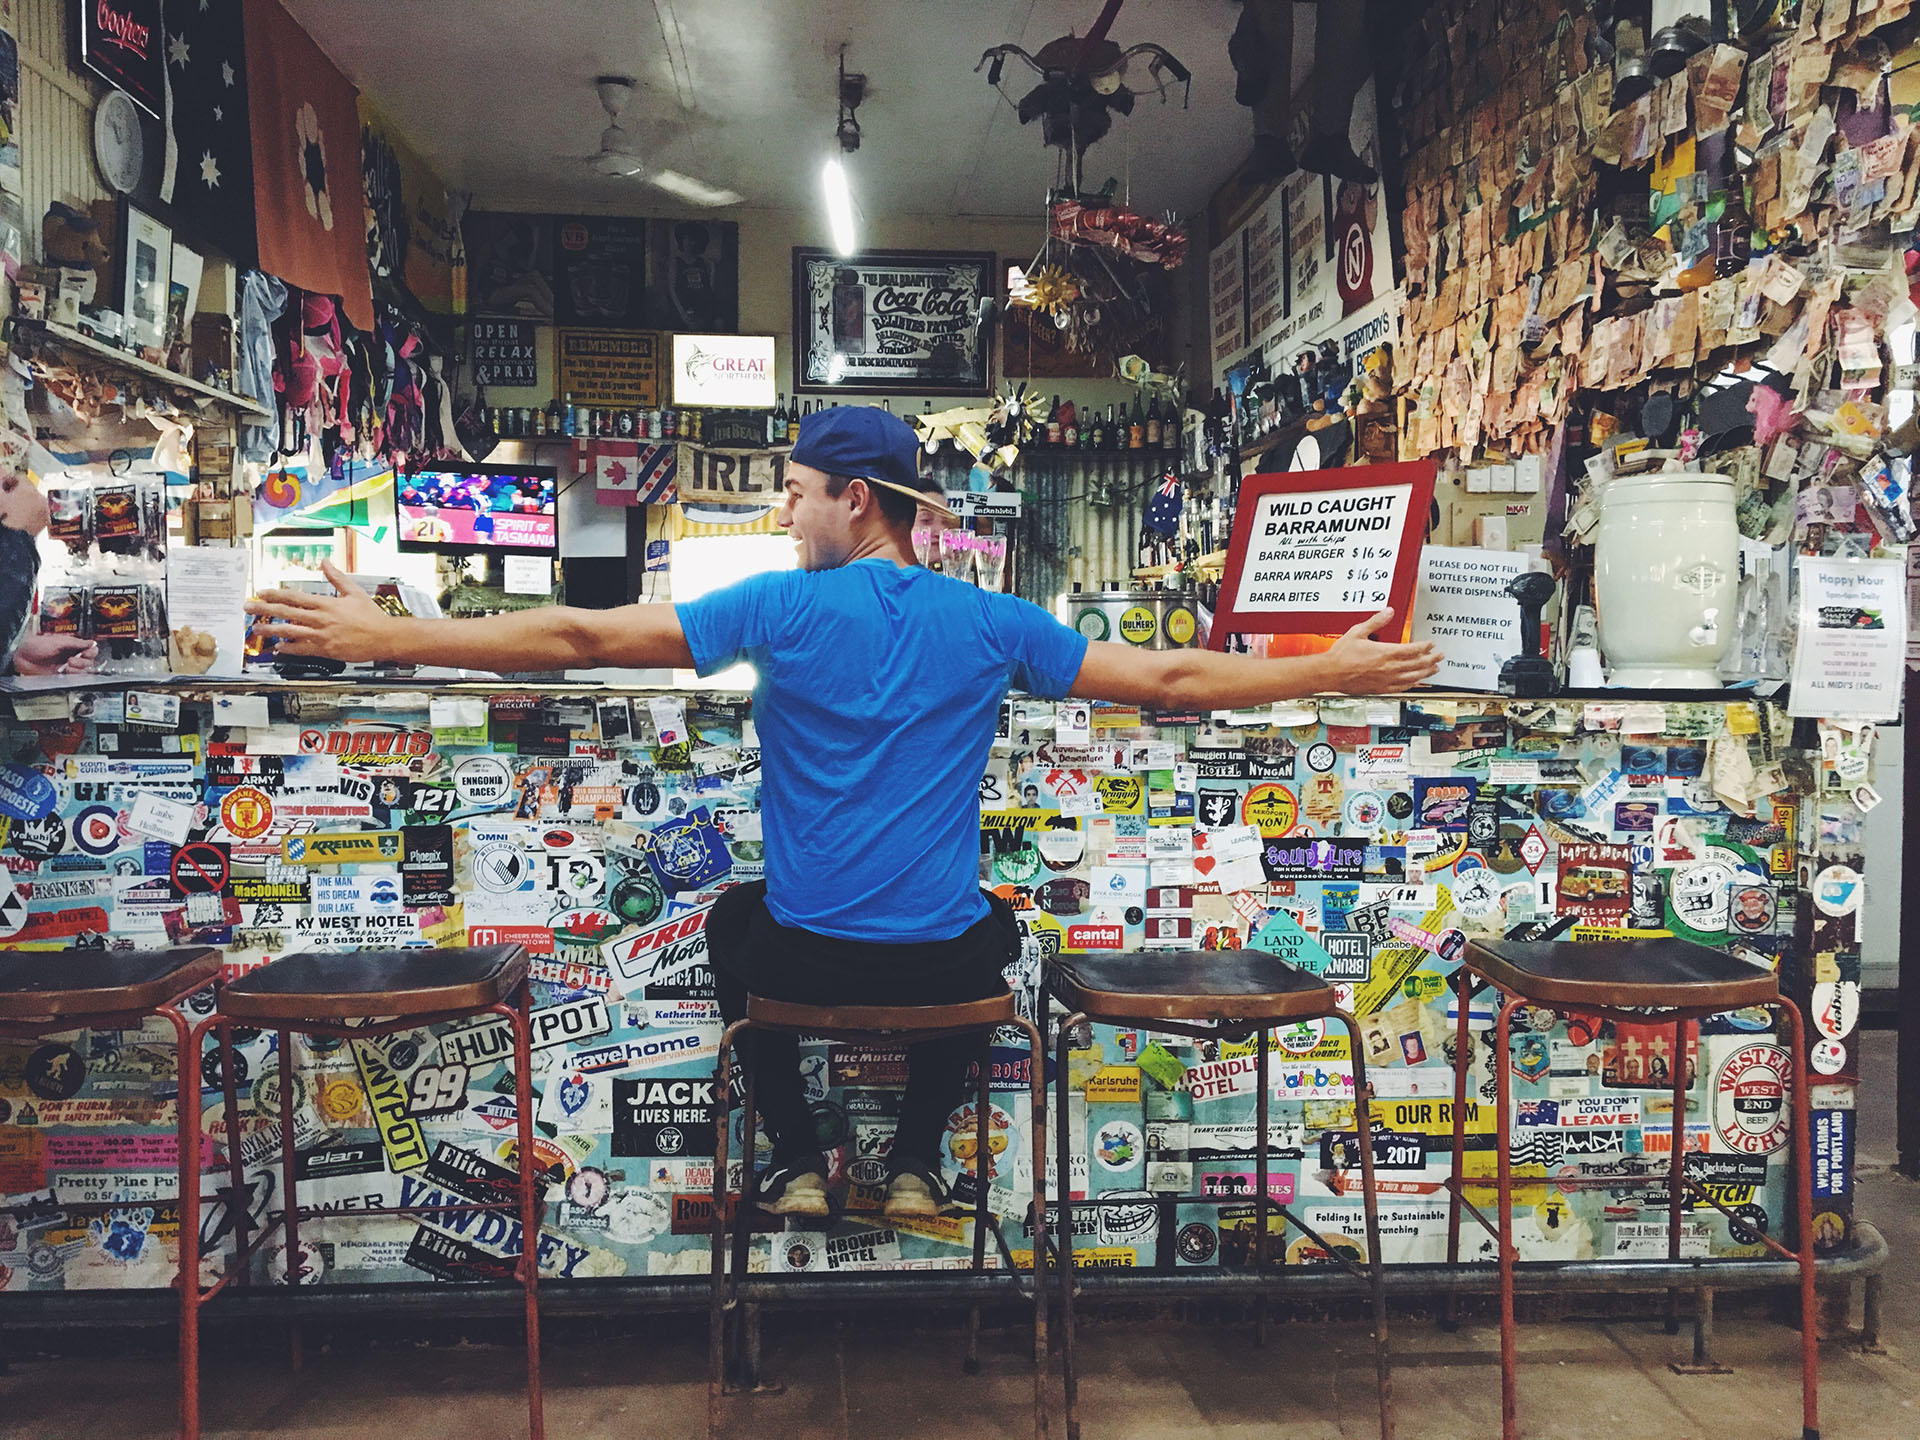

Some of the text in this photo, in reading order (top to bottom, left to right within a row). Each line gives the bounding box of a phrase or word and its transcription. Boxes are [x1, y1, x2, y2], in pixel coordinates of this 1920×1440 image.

[474, 324, 519, 338] OPEN
[1344, 310, 1390, 354] TERRITORY'S
[476, 346, 533, 358] RELAX
[568, 340, 649, 354] REMEMBER
[713, 357, 767, 372] GREAT
[494, 365, 535, 378] PRAY
[1269, 496, 1396, 518] WILD CAUGHT
[416, 522, 437, 538] 21
[496, 519, 550, 532] SPIRIT OF
[1264, 516, 1391, 537] BARRAMUNDI
[497, 531, 555, 547] TASMANIA
[1258, 550, 1296, 561] BARRA
[1297, 548, 1345, 560] BURGER
[1429, 559, 1520, 574] PLEASE DO NOT FILL
[1253, 571, 1290, 582] BARRA
[1290, 569, 1333, 581] WRAPS
[1428, 573, 1498, 586] BOTTLES FROM
[1818, 573, 1885, 587] Happy Hour
[1249, 592, 1287, 603] BARRA
[1288, 591, 1320, 602] BITES
[1430, 584, 1463, 597] WATER
[1122, 619, 1155, 630] BULMERS
[1427, 613, 1513, 628] ASK A MEMBER OF
[1431, 626, 1506, 641] STAFF TO REFILL
[1446, 660, 1487, 672] Thank you
[1811, 681, 1826, 690] ALL
[327, 730, 432, 755] DAVIS
[338, 753, 412, 768] Motorsport
[1228, 751, 1246, 760] Arms
[540, 759, 593, 768] NEIGHBORHOOD
[1249, 762, 1293, 778] NYNGAN
[1197, 763, 1242, 778] HOTEL
[218, 775, 276, 785] RED ARMY
[462, 776, 503, 787] ENNGONIA
[469, 787, 496, 797] RACES
[413, 788, 453, 811] 121
[573, 794, 622, 804] CHAMPIONS
[1257, 812, 1289, 827] NON!
[477, 833, 509, 841] OMNI
[310, 838, 374, 856] KREUTH
[1527, 845, 1541, 854] 34
[410, 849, 442, 864] Phoenix
[1267, 846, 1314, 868] SQUID
[1329, 847, 1363, 868] LIPS
[317, 877, 333, 887] ONE
[32, 879, 96, 899] FRANKEN
[234, 883, 303, 898] MacDONNELL
[317, 890, 331, 899] HIS
[317, 903, 334, 912] OUR
[295, 915, 415, 929] KY WEST HOTEL
[297, 928, 415, 938] Always Happy Ending
[504, 933, 550, 941] CHEERS FROM
[1073, 928, 1120, 941] cantal
[333, 937, 365, 945] 5859
[1264, 935, 1304, 947] LAND
[1328, 939, 1364, 956] HOTEL
[1272, 947, 1299, 958] FOR
[677, 1001, 715, 1011] Kirby's
[655, 1008, 706, 1019] Katherine
[629, 1043, 719, 1067] campervakanties
[835, 1053, 907, 1063] Ute Muster
[1309, 1050, 1347, 1060] country
[992, 1057, 1032, 1081] ROCK
[1718, 1048, 1761, 1092] WEST
[1089, 1075, 1139, 1086] Karlsruhe
[411, 1065, 466, 1112] 99
[627, 1082, 715, 1106] JACK
[1277, 1088, 1354, 1097] BEACH
[1739, 1084, 1778, 1096] WEST
[38, 1100, 107, 1111] DON'T BURN
[1561, 1096, 1640, 1107] IF YOU DON'T
[1742, 1099, 1772, 1110] END
[487, 1106, 513, 1117] METAL
[1395, 1103, 1433, 1125] OUR
[1579, 1104, 1623, 1114] LOVE IT
[489, 1117, 507, 1126] SHOP
[633, 1108, 711, 1124] LIVES HERE.
[1561, 1113, 1640, 1127] LEAVE!
[1746, 1115, 1769, 1125] BEER
[1193, 1126, 1233, 1134] EVANS HEAD
[1723, 1122, 1791, 1154] LIGHT
[307, 1150, 364, 1167] elan
[1386, 1146, 1421, 1165] 2017
[1816, 1117, 1830, 1190] WIND FARMS
[1831, 1111, 1844, 1195] FOR PORTLAND
[438, 1145, 488, 1180] Elite
[1578, 1162, 1619, 1175] Track
[1703, 1160, 1765, 1175] Deckchair Cinema
[850, 1162, 887, 1183] RUGBY
[58, 1176, 149, 1190] Pretty Pine
[1204, 1184, 1231, 1195] THE
[1316, 1211, 1446, 1224] Folding Is Sustainable
[1342, 1225, 1365, 1235] Than
[418, 1230, 468, 1263] Elite
[828, 1250, 877, 1267] HOTEL
[1083, 1258, 1133, 1267] CAMELS
